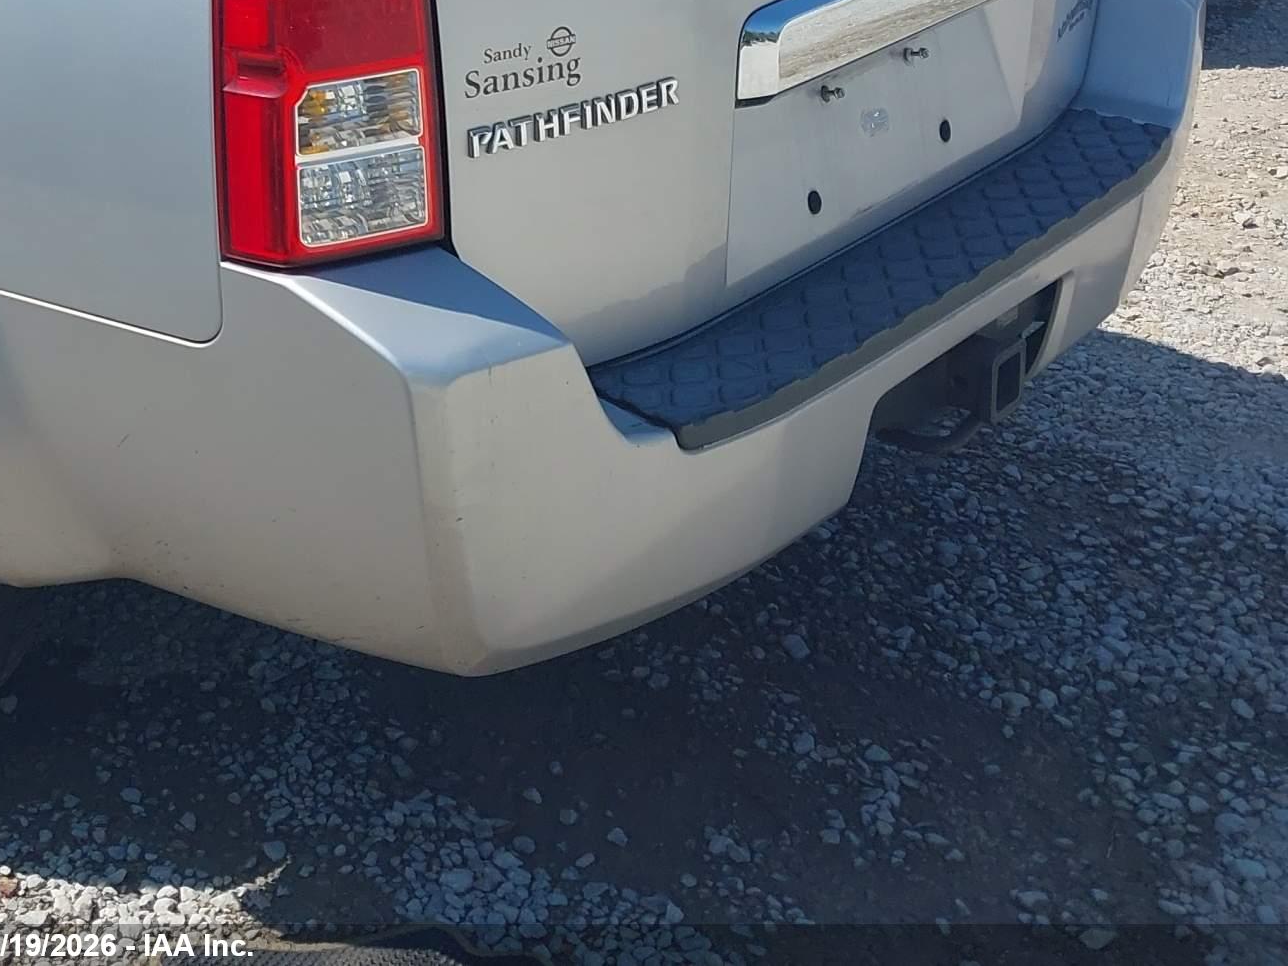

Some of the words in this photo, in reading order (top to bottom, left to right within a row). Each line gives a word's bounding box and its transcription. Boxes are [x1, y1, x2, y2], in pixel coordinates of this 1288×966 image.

[483, 42, 532, 65] Sandy
[464, 56, 582, 99] Sansing
[467, 76, 680, 159] PATHFINDER
